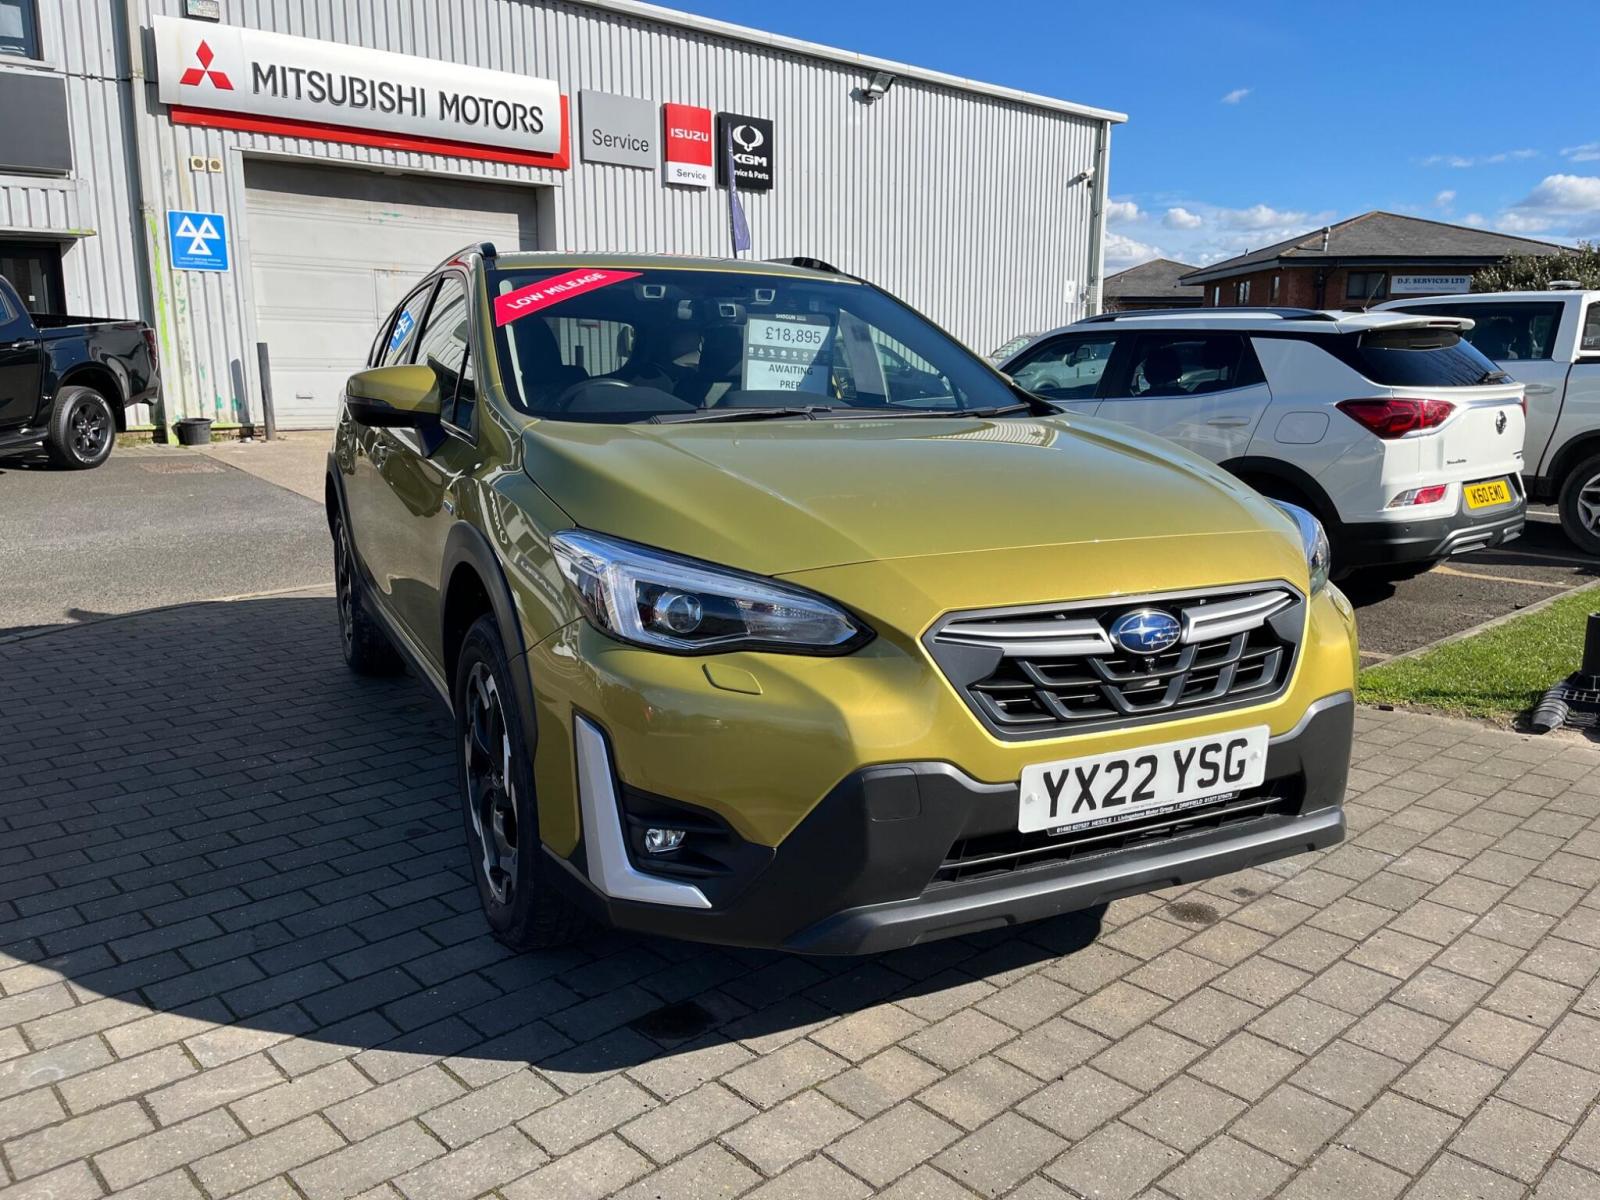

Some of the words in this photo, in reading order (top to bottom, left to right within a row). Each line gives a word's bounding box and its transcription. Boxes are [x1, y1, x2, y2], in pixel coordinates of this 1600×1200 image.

[252, 61, 426, 118] MITSUBISHI
[439, 91, 544, 134] MOTORS
[592, 128, 649, 153] Service
[670, 127, 709, 142] ISUZU
[676, 168, 707, 181] Service
[734, 169, 749, 179] rvice
[748, 171, 754, 179] &
[754, 171, 769, 180] Parts
[1413, 277, 1450, 285] SERVICES
[1451, 277, 1466, 285] LTD
[506, 292, 542, 309] LOW
[544, 272, 608, 296] MILEAGE
[765, 326, 822, 345] £18,895
[768, 363, 813, 376] AWAITING
[779, 379, 801, 390] PREP
[1470, 486, 1489, 504] K60
[1042, 755, 1158, 818] YX22
[1173, 738, 1248, 793] YSG
